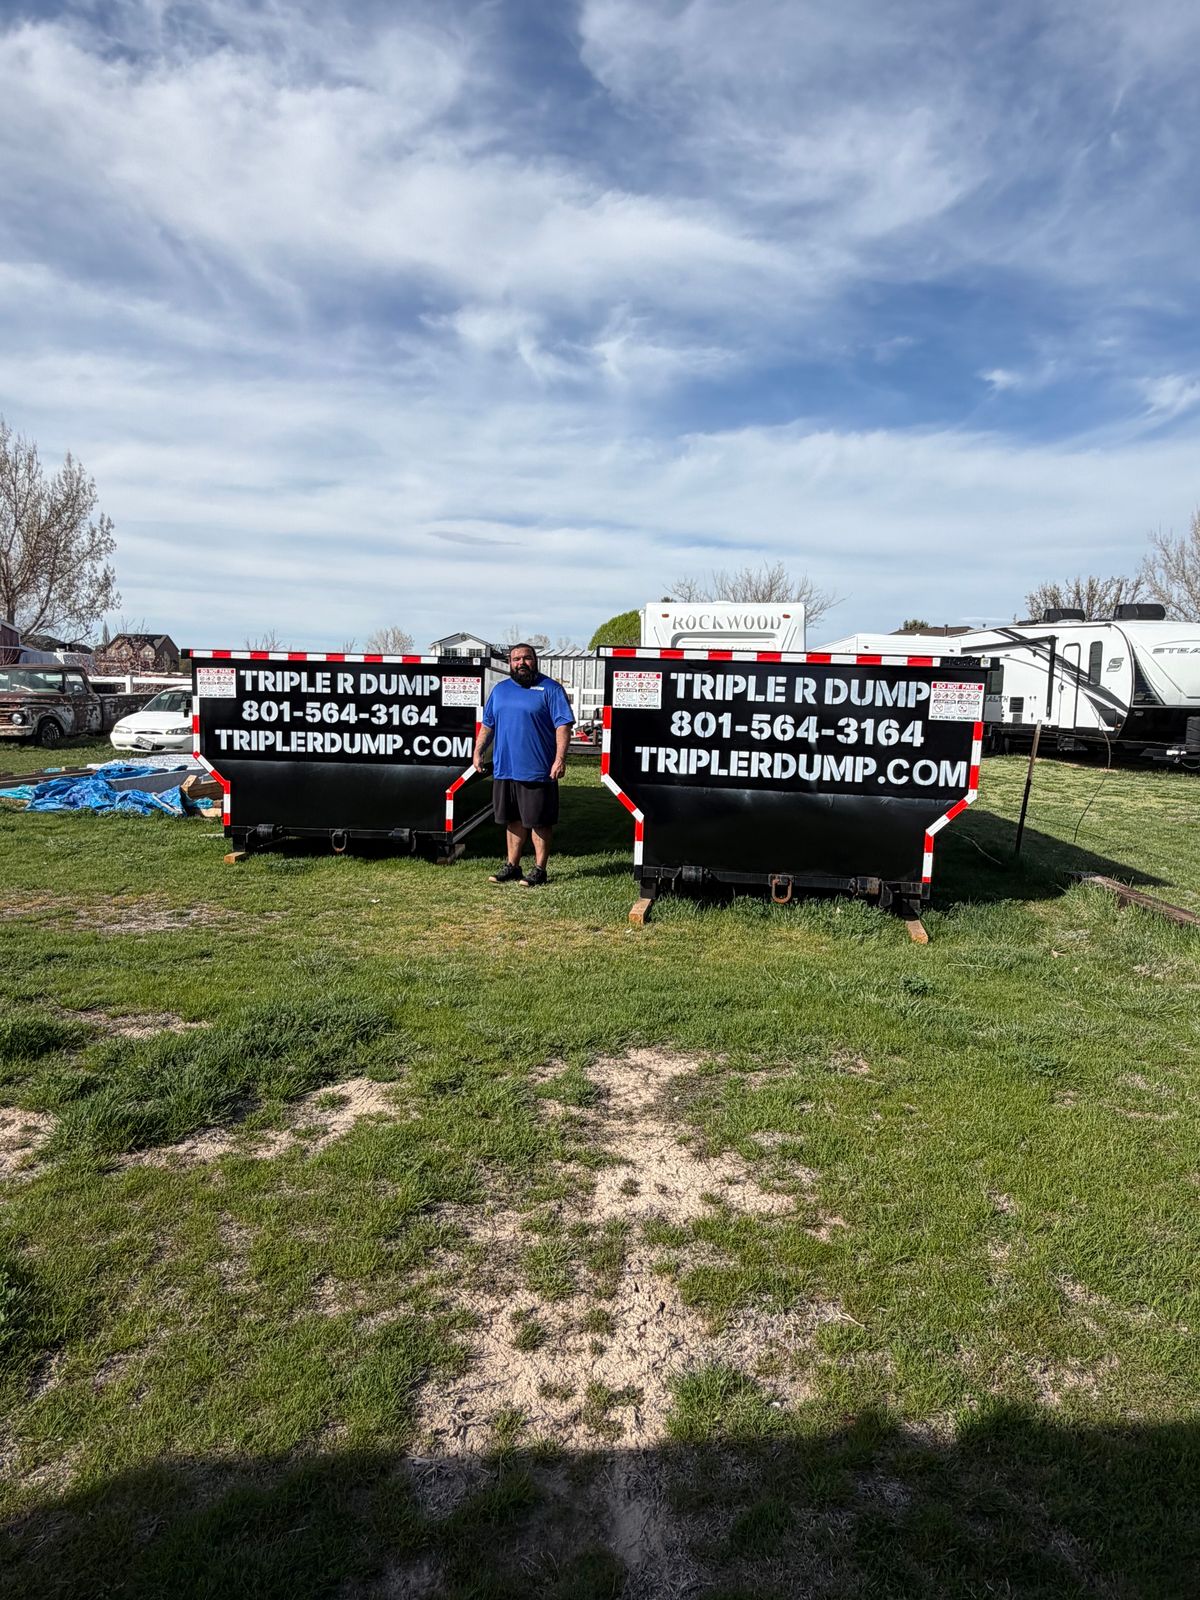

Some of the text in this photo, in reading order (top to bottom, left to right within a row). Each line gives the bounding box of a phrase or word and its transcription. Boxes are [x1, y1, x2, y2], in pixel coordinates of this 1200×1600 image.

[672, 614, 781, 630] ROCKWOOD
[240, 669, 441, 697] TRIPLE R DUMP
[670, 672, 931, 708] TRIPLE R DUMP
[241, 700, 439, 727] 801-564-3164
[214, 729, 473, 758] TRIPLERDUMP.COM
[670, 711, 925, 748] 801-564-3164
[634, 745, 968, 788] TRIPLERDUMP.COM
